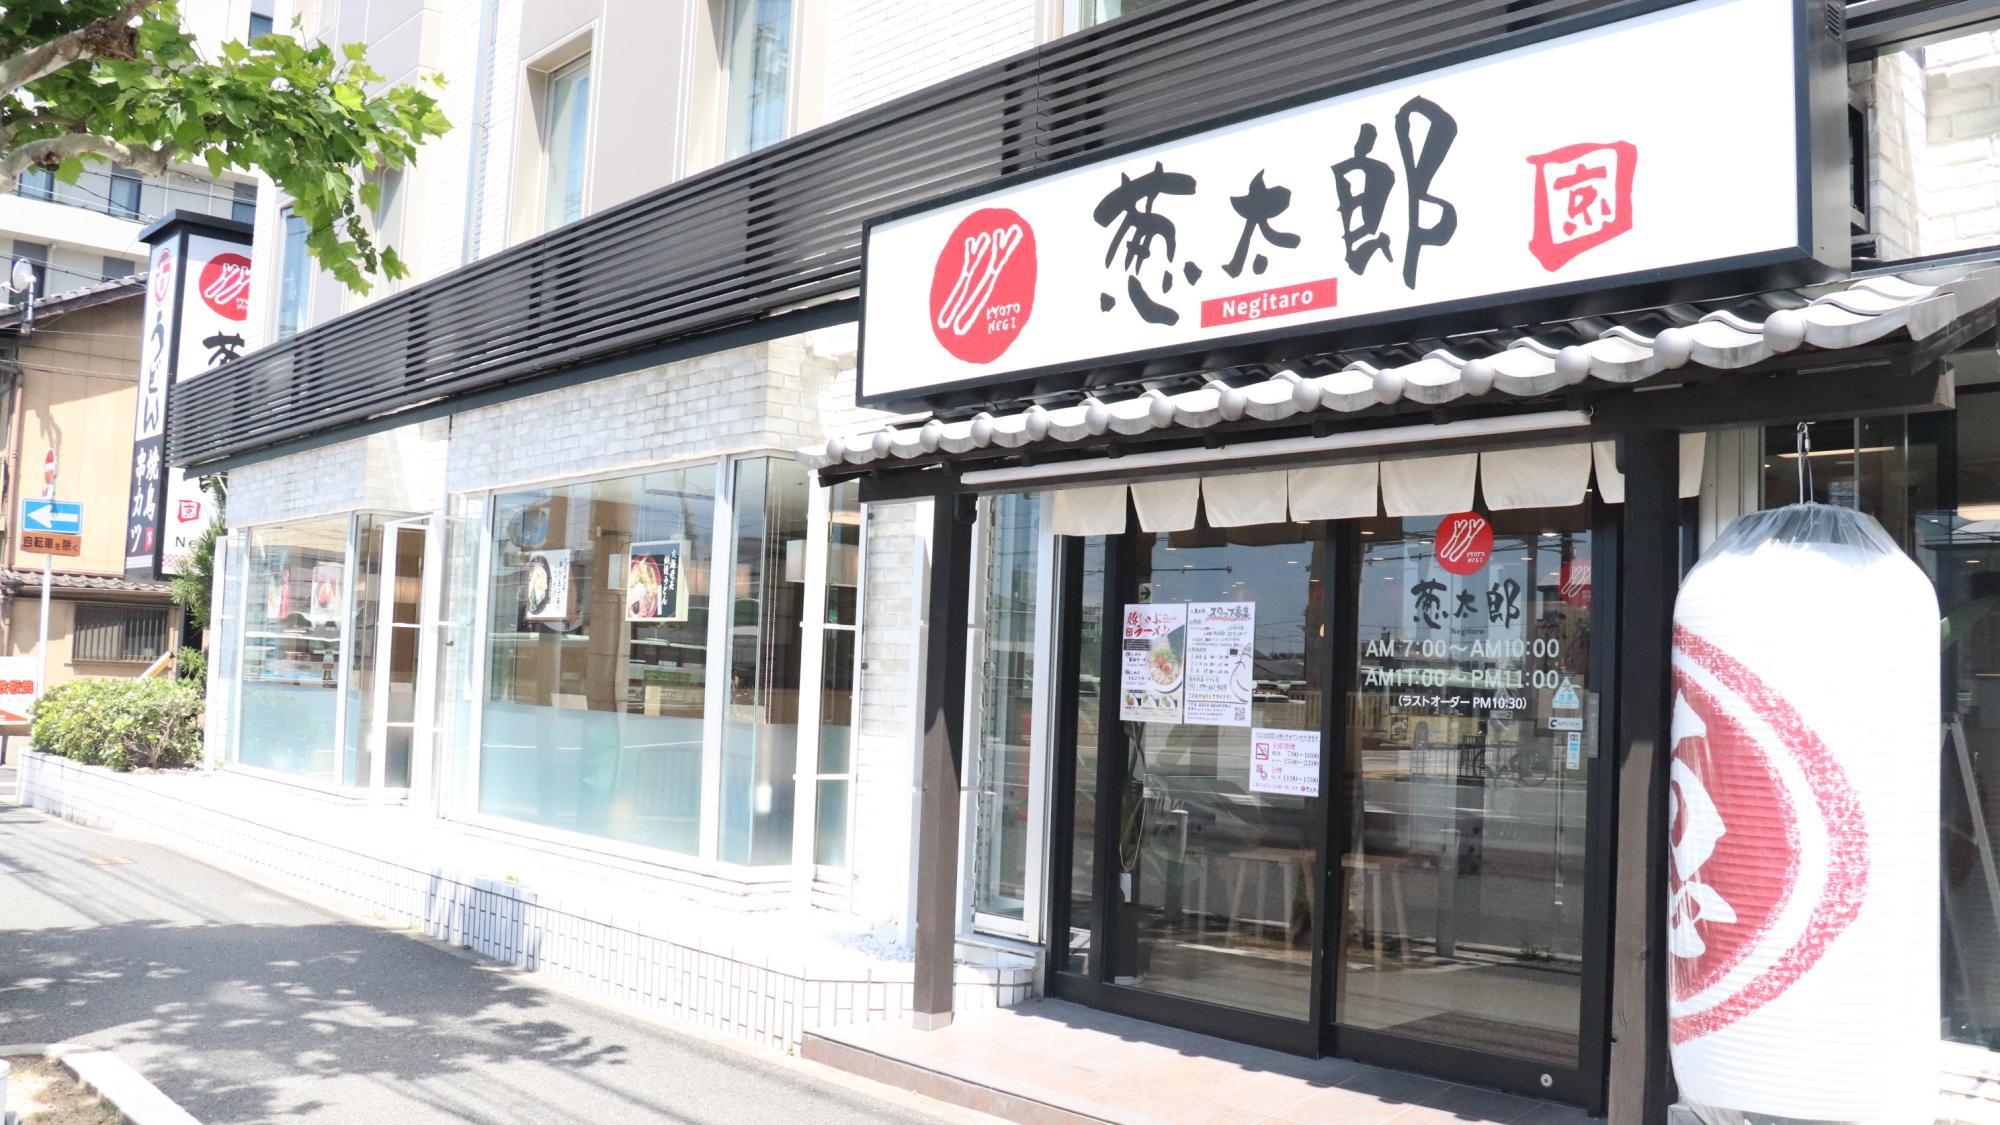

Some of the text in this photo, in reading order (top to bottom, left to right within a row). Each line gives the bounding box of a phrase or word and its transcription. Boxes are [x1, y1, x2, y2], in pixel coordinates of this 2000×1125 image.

[1093, 95, 1457, 326] 葱太郎
[986, 302, 1021, 320] KYOTO
[987, 317, 1017, 334] NEGI
[1222, 290, 1313, 319] Negitaro
[143, 310, 165, 434] うどん
[130, 447, 146, 553] 串カツ
[143, 446, 160, 521] 焼鳥
[23, 535, 79, 552] 自転車を除く
[1410, 578, 1520, 630] 葱太郎
